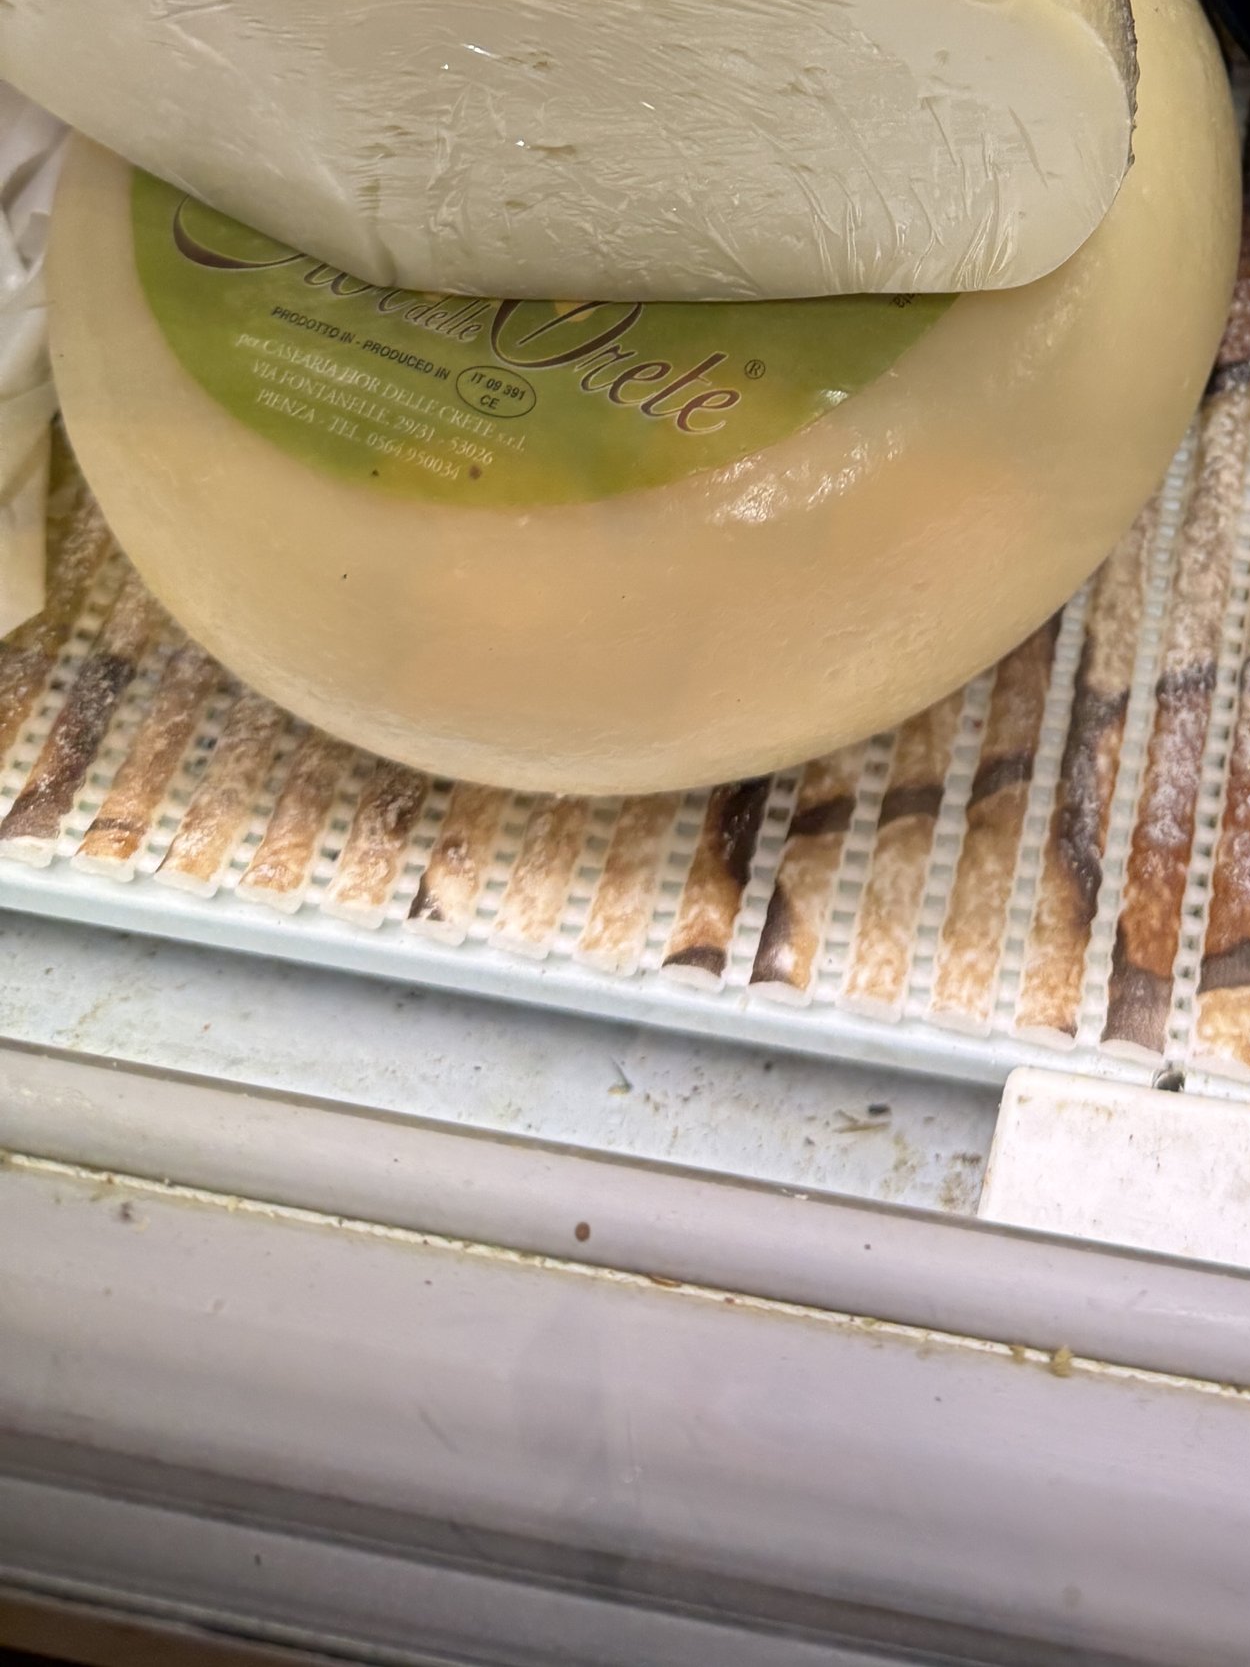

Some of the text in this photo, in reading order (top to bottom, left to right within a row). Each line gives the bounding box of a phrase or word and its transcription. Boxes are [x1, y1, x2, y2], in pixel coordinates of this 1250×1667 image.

[272, 306, 340, 338] PRODOTTO
[340, 330, 355, 345] IN
[362, 340, 434, 375] PRODUCED
[435, 364, 450, 380] IN
[404, 294, 491, 343] delle
[256, 388, 317, 424] PIENZA
[382, 383, 440, 414] DELLE
[440, 405, 498, 437] CRETE
[471, 372, 485, 385] IT
[504, 385, 526, 401] 391
[480, 395, 499, 410] CE
[252, 359, 278, 381] VIA
[396, 415, 436, 442] 29/31
[450, 435, 494, 465] 53026
